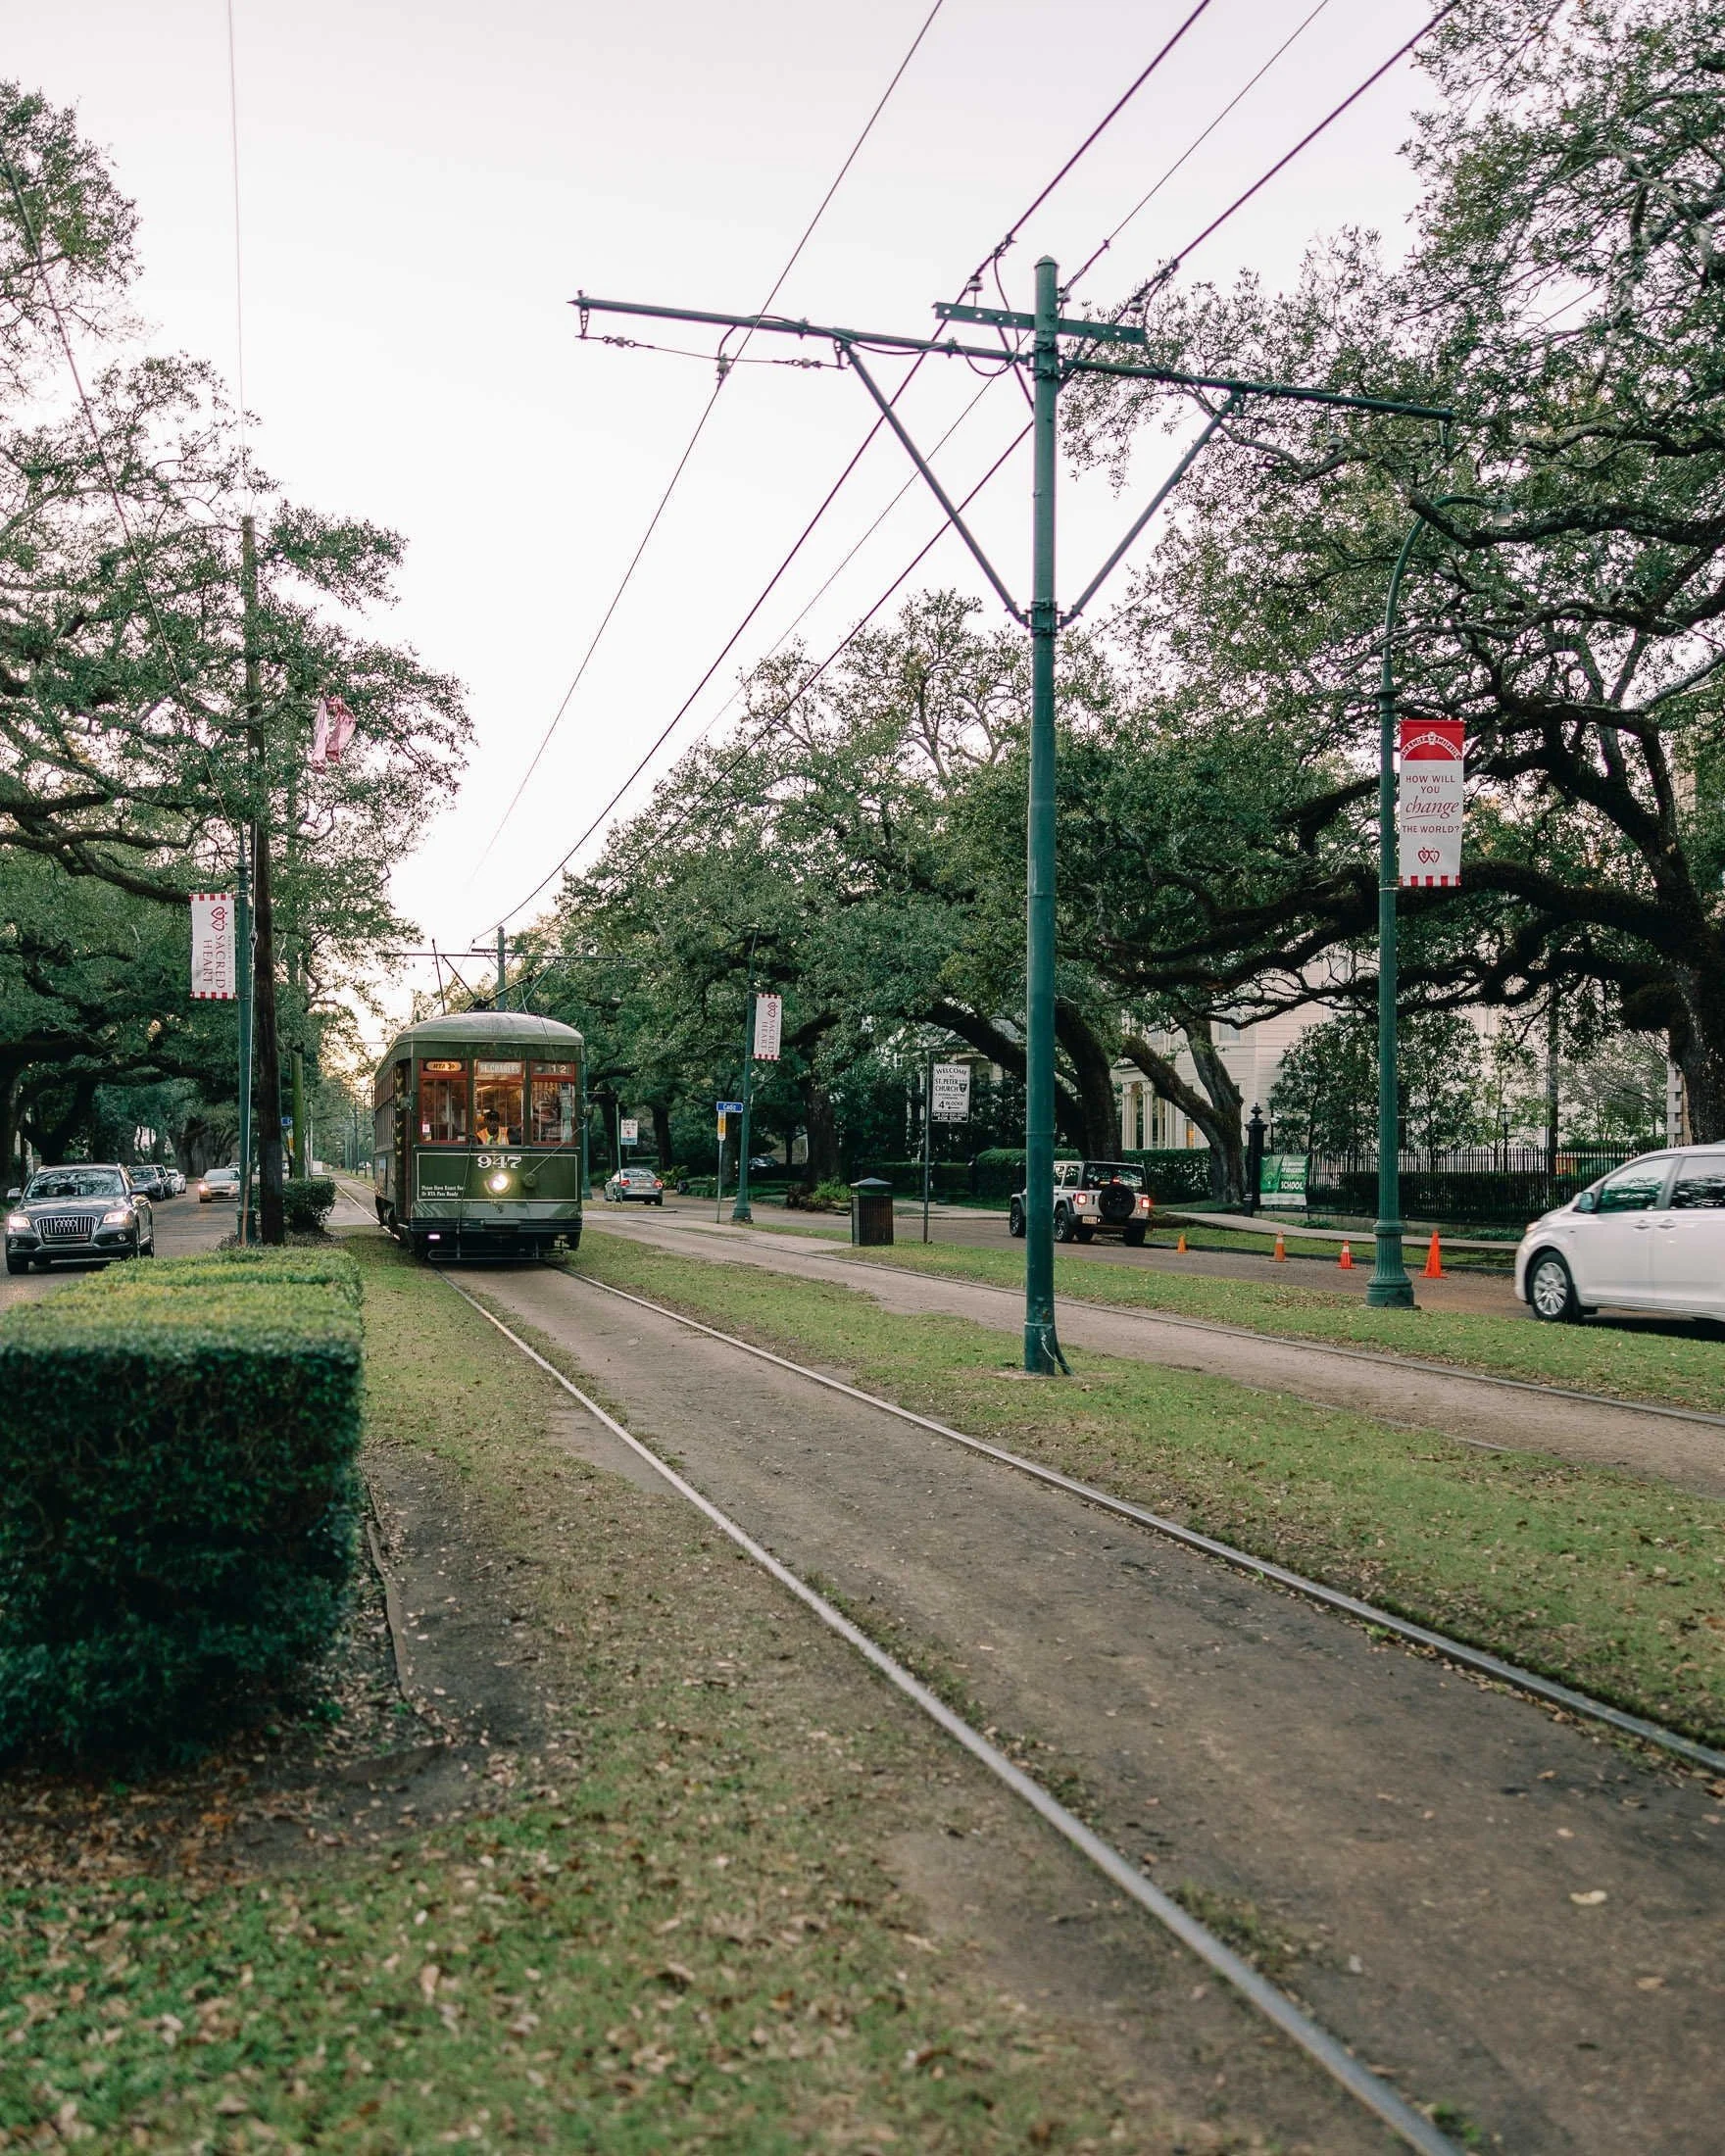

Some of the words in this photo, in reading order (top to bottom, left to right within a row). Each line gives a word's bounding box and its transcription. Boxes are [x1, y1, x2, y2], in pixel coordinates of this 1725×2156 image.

[1420, 785, 1440, 794] YOU
[1405, 795, 1459, 819] change
[203, 940, 214, 985] HEART
[216, 934, 226, 989] SACRED
[476, 1155, 522, 1169] 947
[1281, 1181, 1304, 1190] SCHOOL
